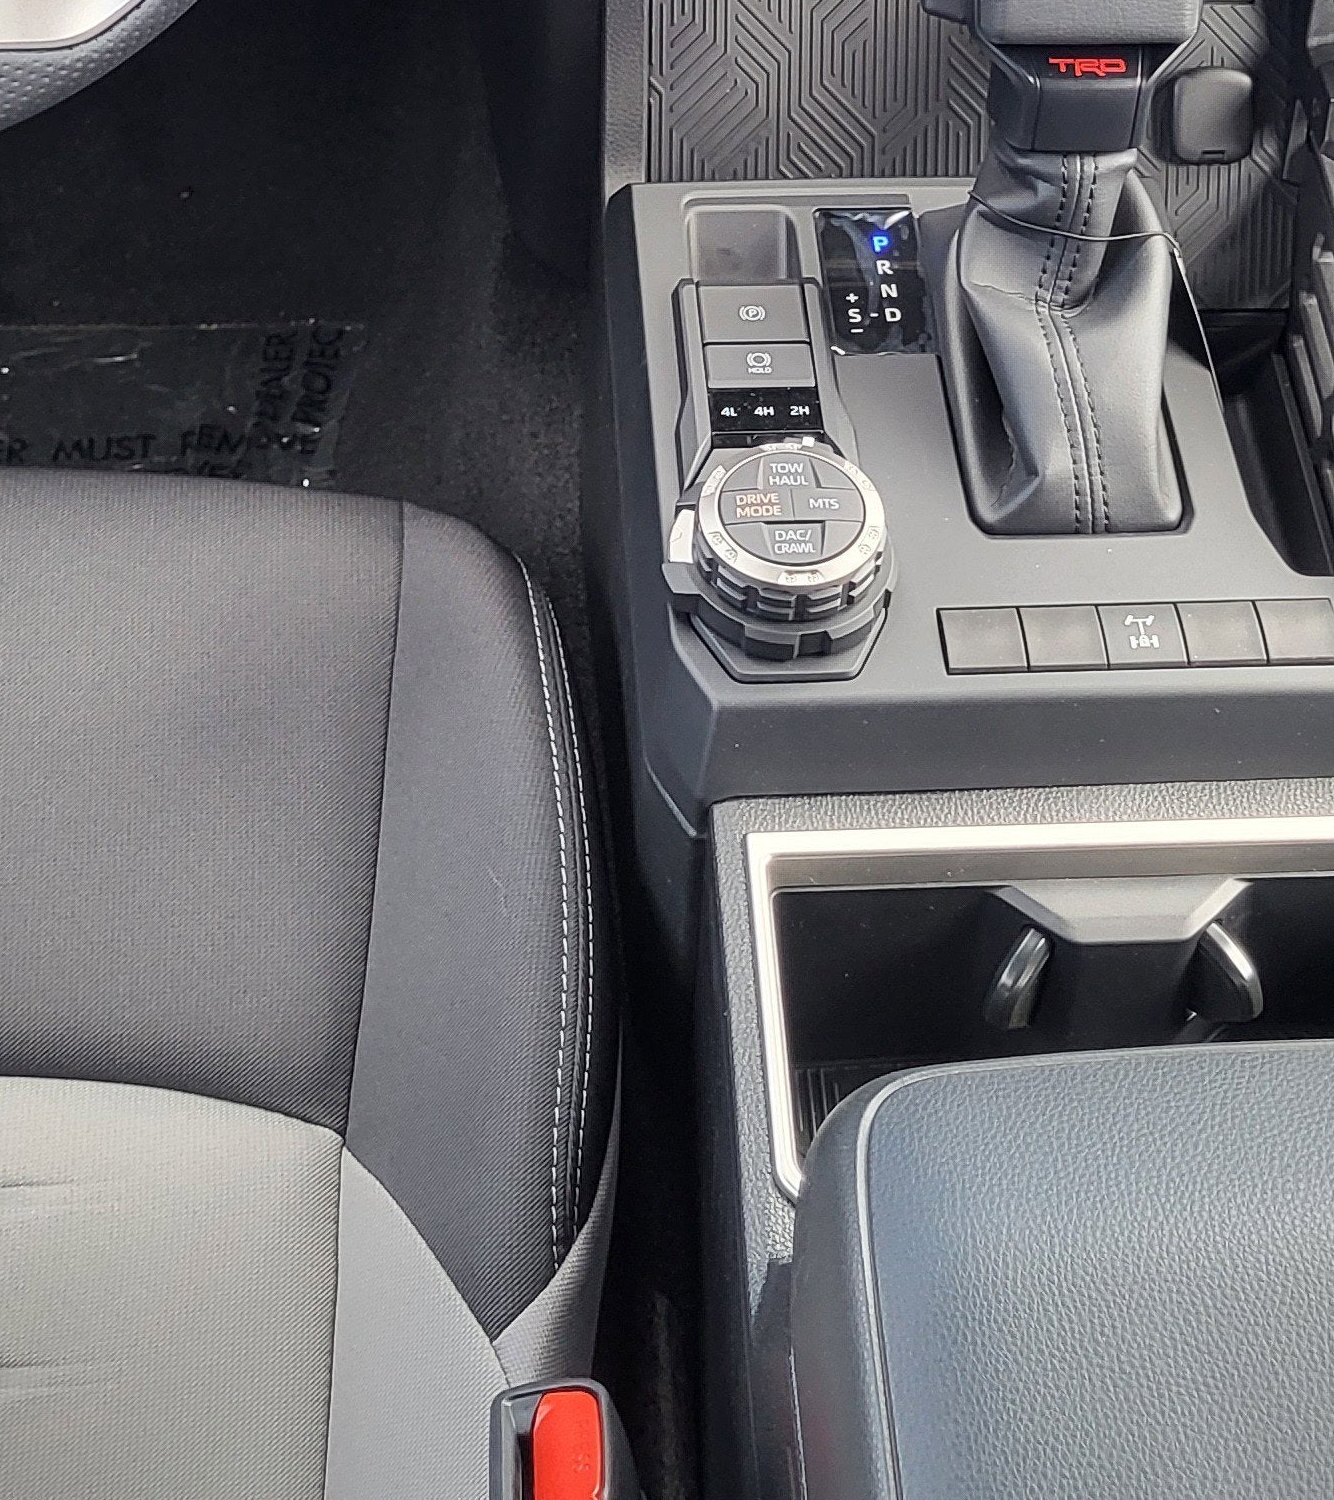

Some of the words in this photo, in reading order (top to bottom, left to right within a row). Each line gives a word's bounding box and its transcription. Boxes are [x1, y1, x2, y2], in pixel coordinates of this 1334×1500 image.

[1048, 57, 1127, 77] TRD
[872, 236, 889, 252] P
[876, 260, 894, 275] R
[880, 284, 899, 298] N
[848, 308, 863, 323] S
[884, 307, 902, 322] D
[747, 367, 772, 375] HOLD
[721, 407, 738, 417] 4L
[754, 406, 775, 417] 4H
[790, 405, 811, 417] 2H
[770, 462, 804, 475] TOW
[769, 475, 809, 487] HAUL
[735, 493, 780, 505] DRIVE
[809, 498, 840, 510] MTS
[736, 506, 782, 518] MODE
[774, 529, 811, 542] DAC/
[774, 542, 817, 554] CRAWL
